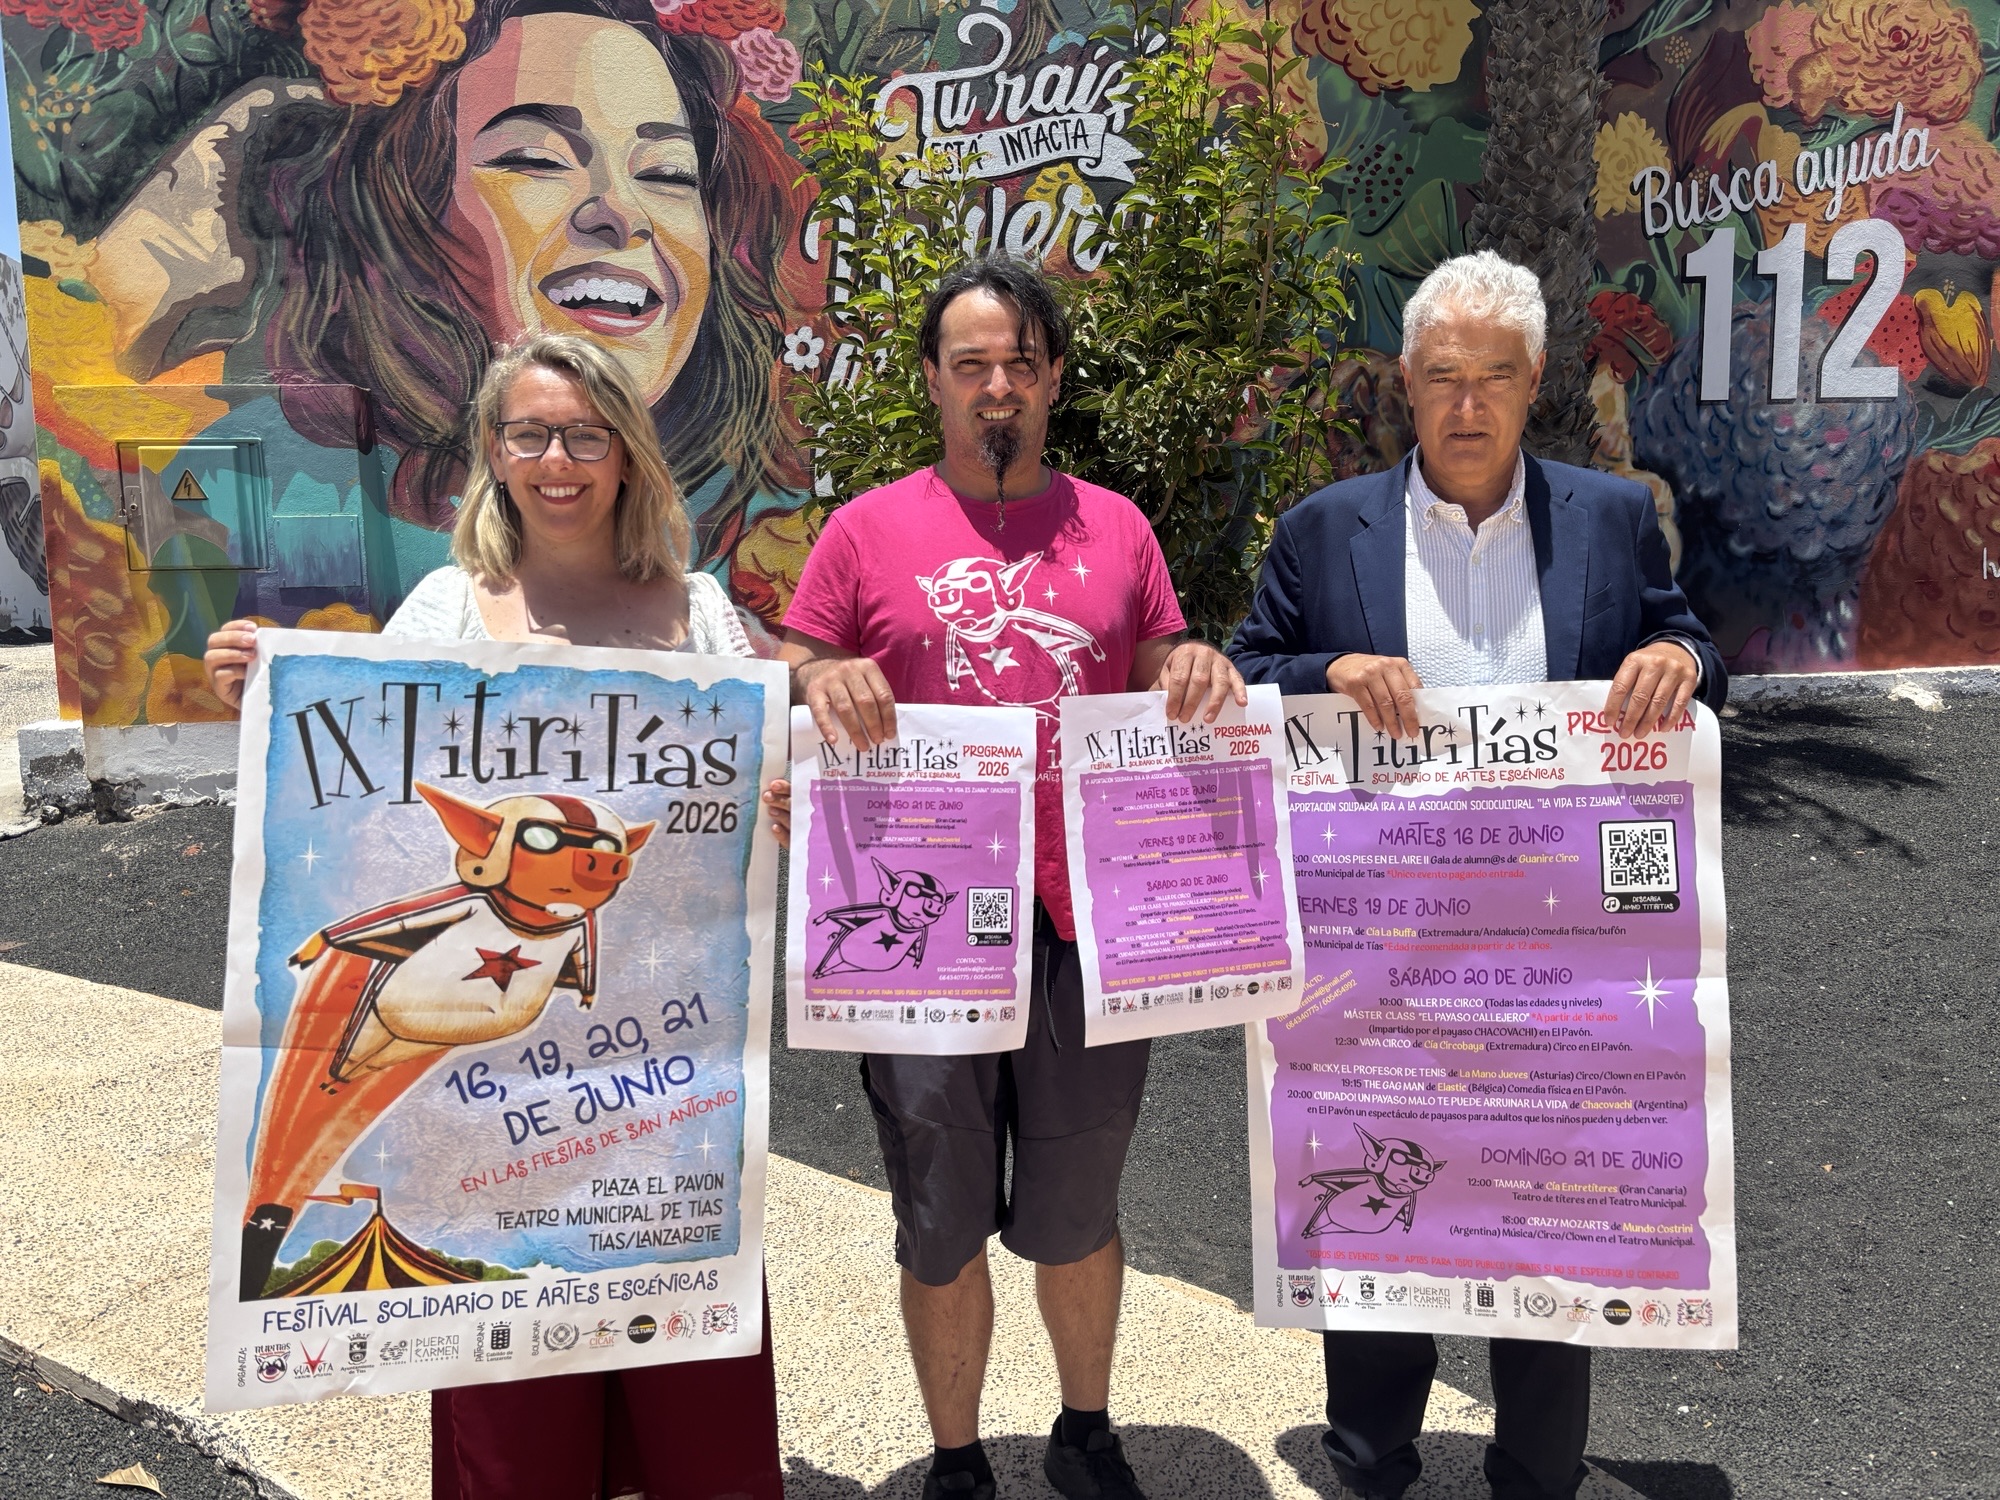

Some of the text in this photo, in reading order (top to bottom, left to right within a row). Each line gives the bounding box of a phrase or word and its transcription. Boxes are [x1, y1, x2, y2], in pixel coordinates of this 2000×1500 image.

[873, 12, 1012, 138] Tu
[1000, 118, 1089, 166] INTACTA
[1632, 101, 1941, 236] Busca ayuda
[1684, 217, 1907, 403] 112
[1214, 723, 1272, 739] PROGRAMA
[1284, 712, 1329, 771] IX
[286, 680, 738, 809] IX TitiriTías
[963, 744, 1023, 758] PROGRAMA
[1085, 730, 1108, 762] IX
[1111, 725, 1211, 768] TitiriTías
[1230, 740, 1259, 756] 2026
[978, 761, 1009, 777] 2026
[1600, 742, 1668, 772] 2026
[1291, 767, 1564, 786] FESTIVAL SOLIDARIO DE ARTES ESCÉNICAS
[1136, 784, 1217, 800] MARTES 16 DE JUNIO
[1289, 800, 1336, 813] APORTACIÓN
[1339, 802, 1379, 812] SOLIDARIA
[1381, 800, 1395, 811] IRÁ
[1398, 802, 1404, 811] A
[1419, 798, 1467, 811] ASOCIACIÓN
[1470, 799, 1534, 811] SOCIOCULTURAL
[1554, 797, 1572, 808] VIDA
[1576, 797, 1587, 807] ES
[1629, 794, 1684, 805] (LANZAROTE)
[666, 800, 738, 834] 2026
[867, 800, 963, 810] DOMINGO 21 DE JUNIO
[1138, 835, 1174, 849] VIERNES
[1187, 833, 1197, 843] DE
[1200, 831, 1224, 843] JUNIO
[1379, 822, 1564, 847] MARTES 16 DE JUNIO
[1312, 854, 1331, 864] CON
[1332, 855, 1351, 864] LOS
[1352, 855, 1373, 864] PIES
[1375, 855, 1388, 864] EN
[1389, 855, 1399, 864] EL
[1401, 855, 1422, 865] AIRE
[1430, 854, 1450, 865] Gala
[1452, 855, 1462, 864] de
[1463, 855, 1505, 865] alumn@s
[1507, 854, 1517, 863] de
[1519, 854, 1553, 863] Guanire
[1555, 853, 1579, 862] Circo
[1147, 874, 1228, 892] SÁBADO 20 DE JUNIO
[1298, 896, 1470, 917] IERNES 19 DE JUNIO
[1389, 966, 1573, 987] SÁBADO 20 DE JUNIO
[1379, 997, 1602, 1009] 10:00 TALLER DE CIRCO (Todas las edades y niveles)
[445, 992, 708, 1104] 16, 19, 20, 21
[503, 1055, 695, 1145] DE JUNIO
[461, 1090, 737, 1193] EN LAS FIESTAS DE SAN ANTONIO
[1481, 1146, 1683, 1170] DOMINGO 21 DE JUNIO
[592, 1169, 724, 1198] PLAZA EL PAVÓN
[496, 1196, 723, 1230] TEATRO MUNICIPAL DE TÍAS
[1501, 1215, 1693, 1234] 18:00 CRAZY MOZARTS de Mundo Costrini
[263, 1270, 718, 1333] FESTIVAL SOLIDARIO DE ARTES ESCÉNICAS
[589, 1336, 614, 1346] CICAR
